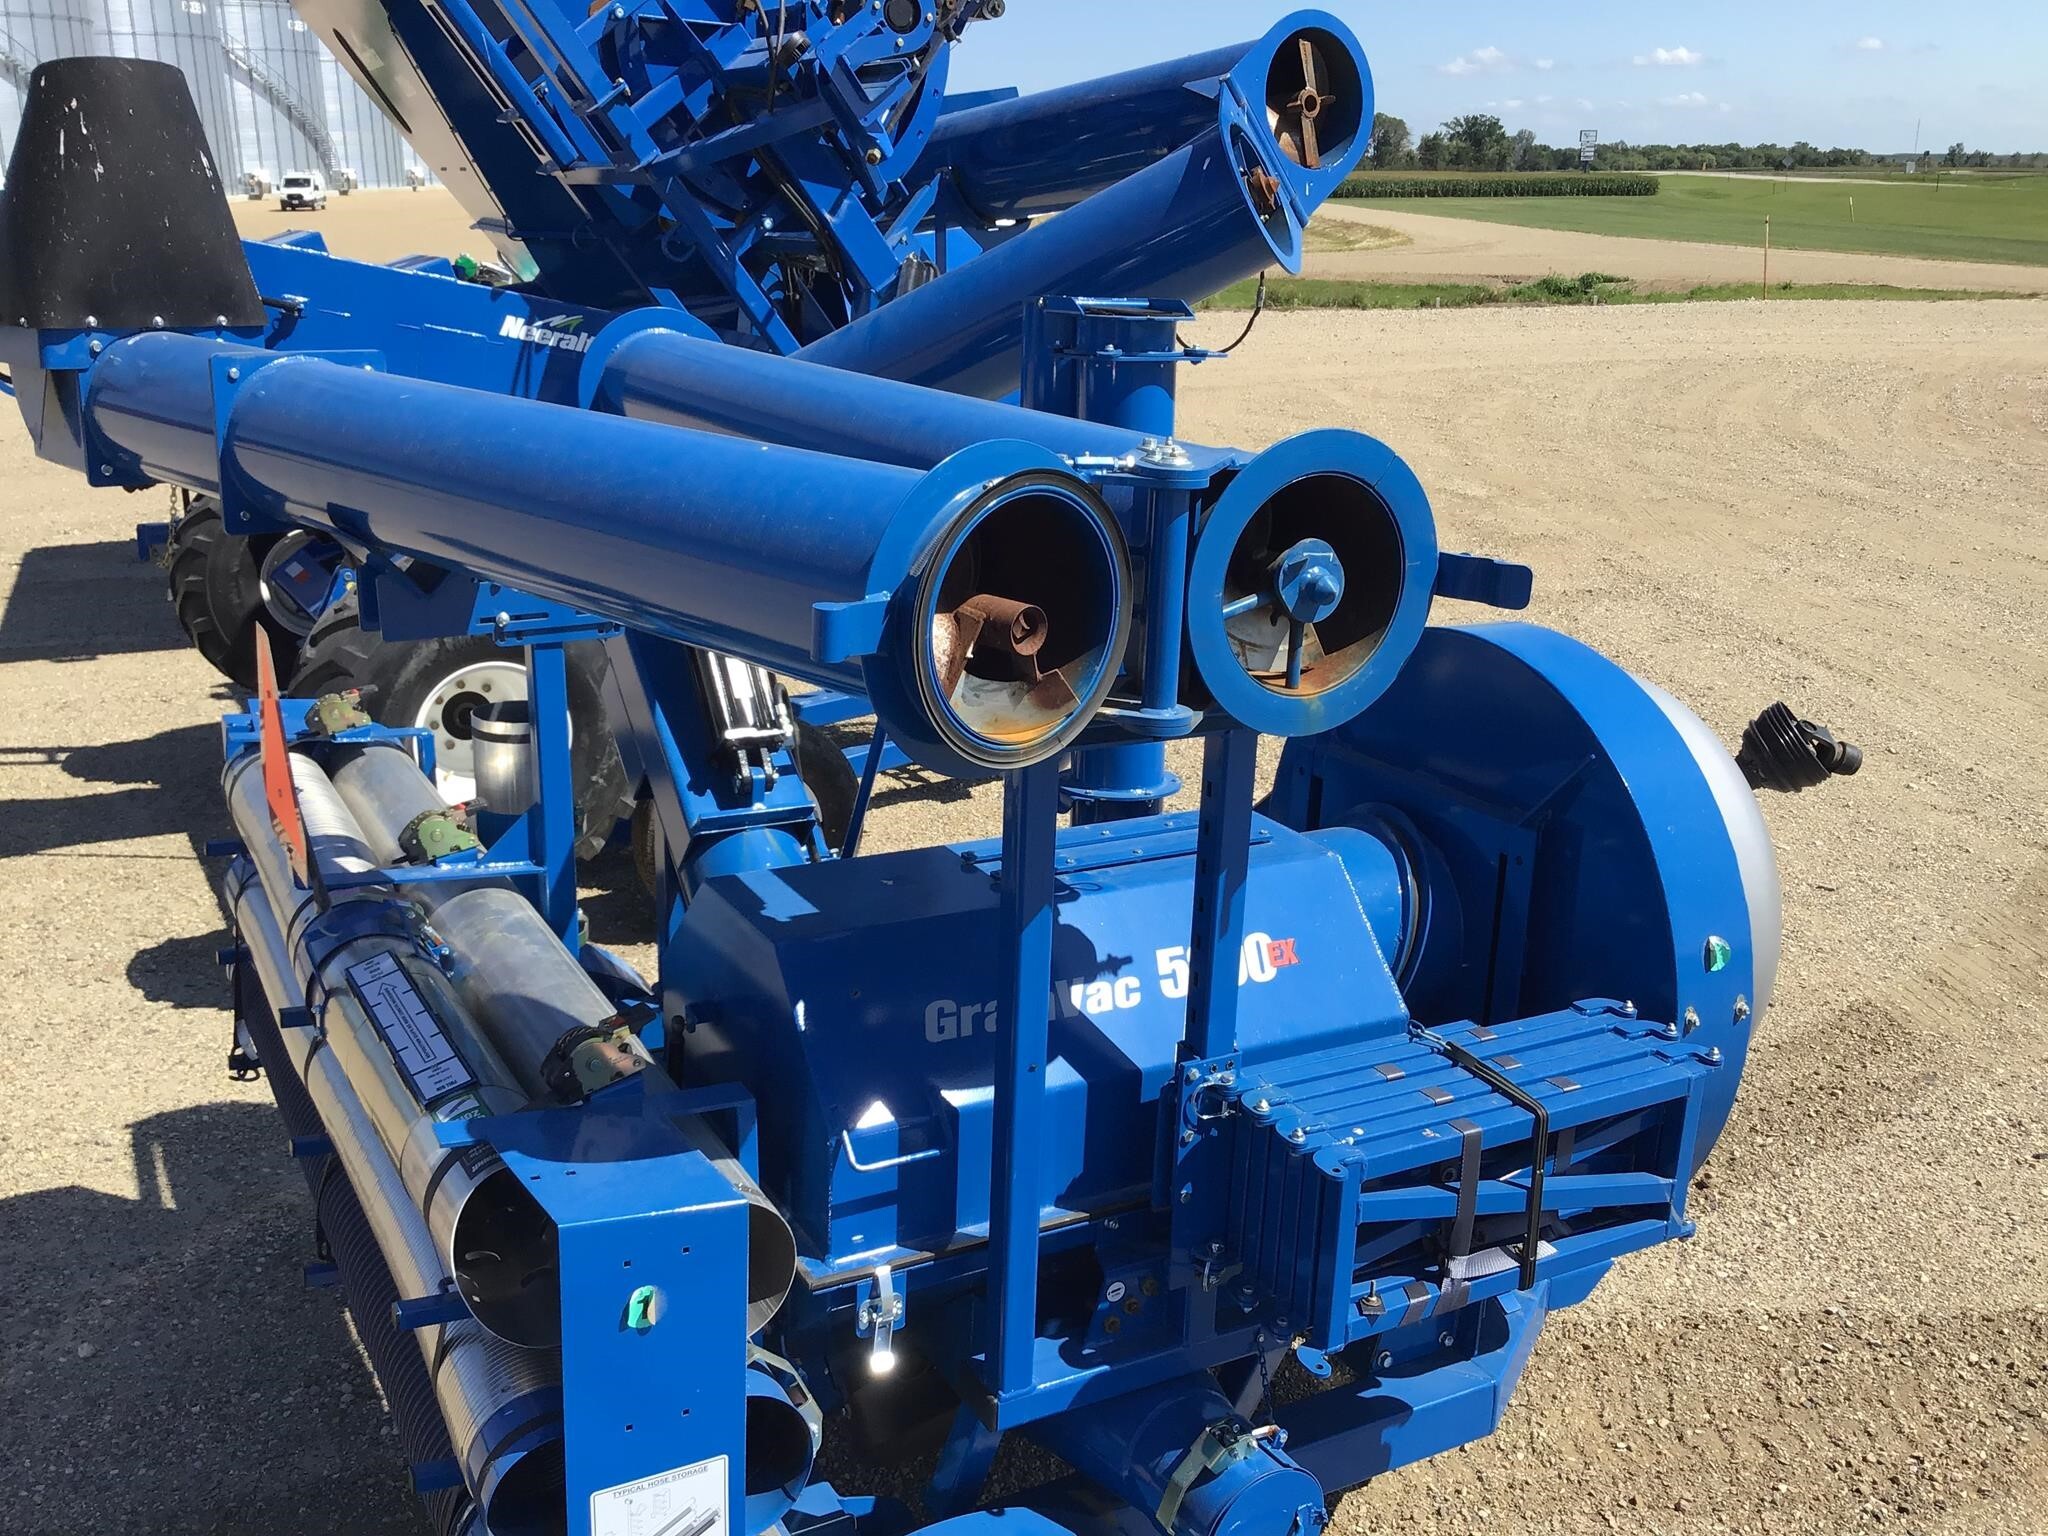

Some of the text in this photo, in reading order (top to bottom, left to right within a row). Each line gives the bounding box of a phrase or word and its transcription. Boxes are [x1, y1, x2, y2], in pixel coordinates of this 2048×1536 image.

[499, 314, 596, 353] Neeralt
[924, 976, 1142, 1043] GraVac
[1155, 932, 1277, 999] 50
[613, 1465, 709, 1499] TYPICAL HOSE STORAGE
